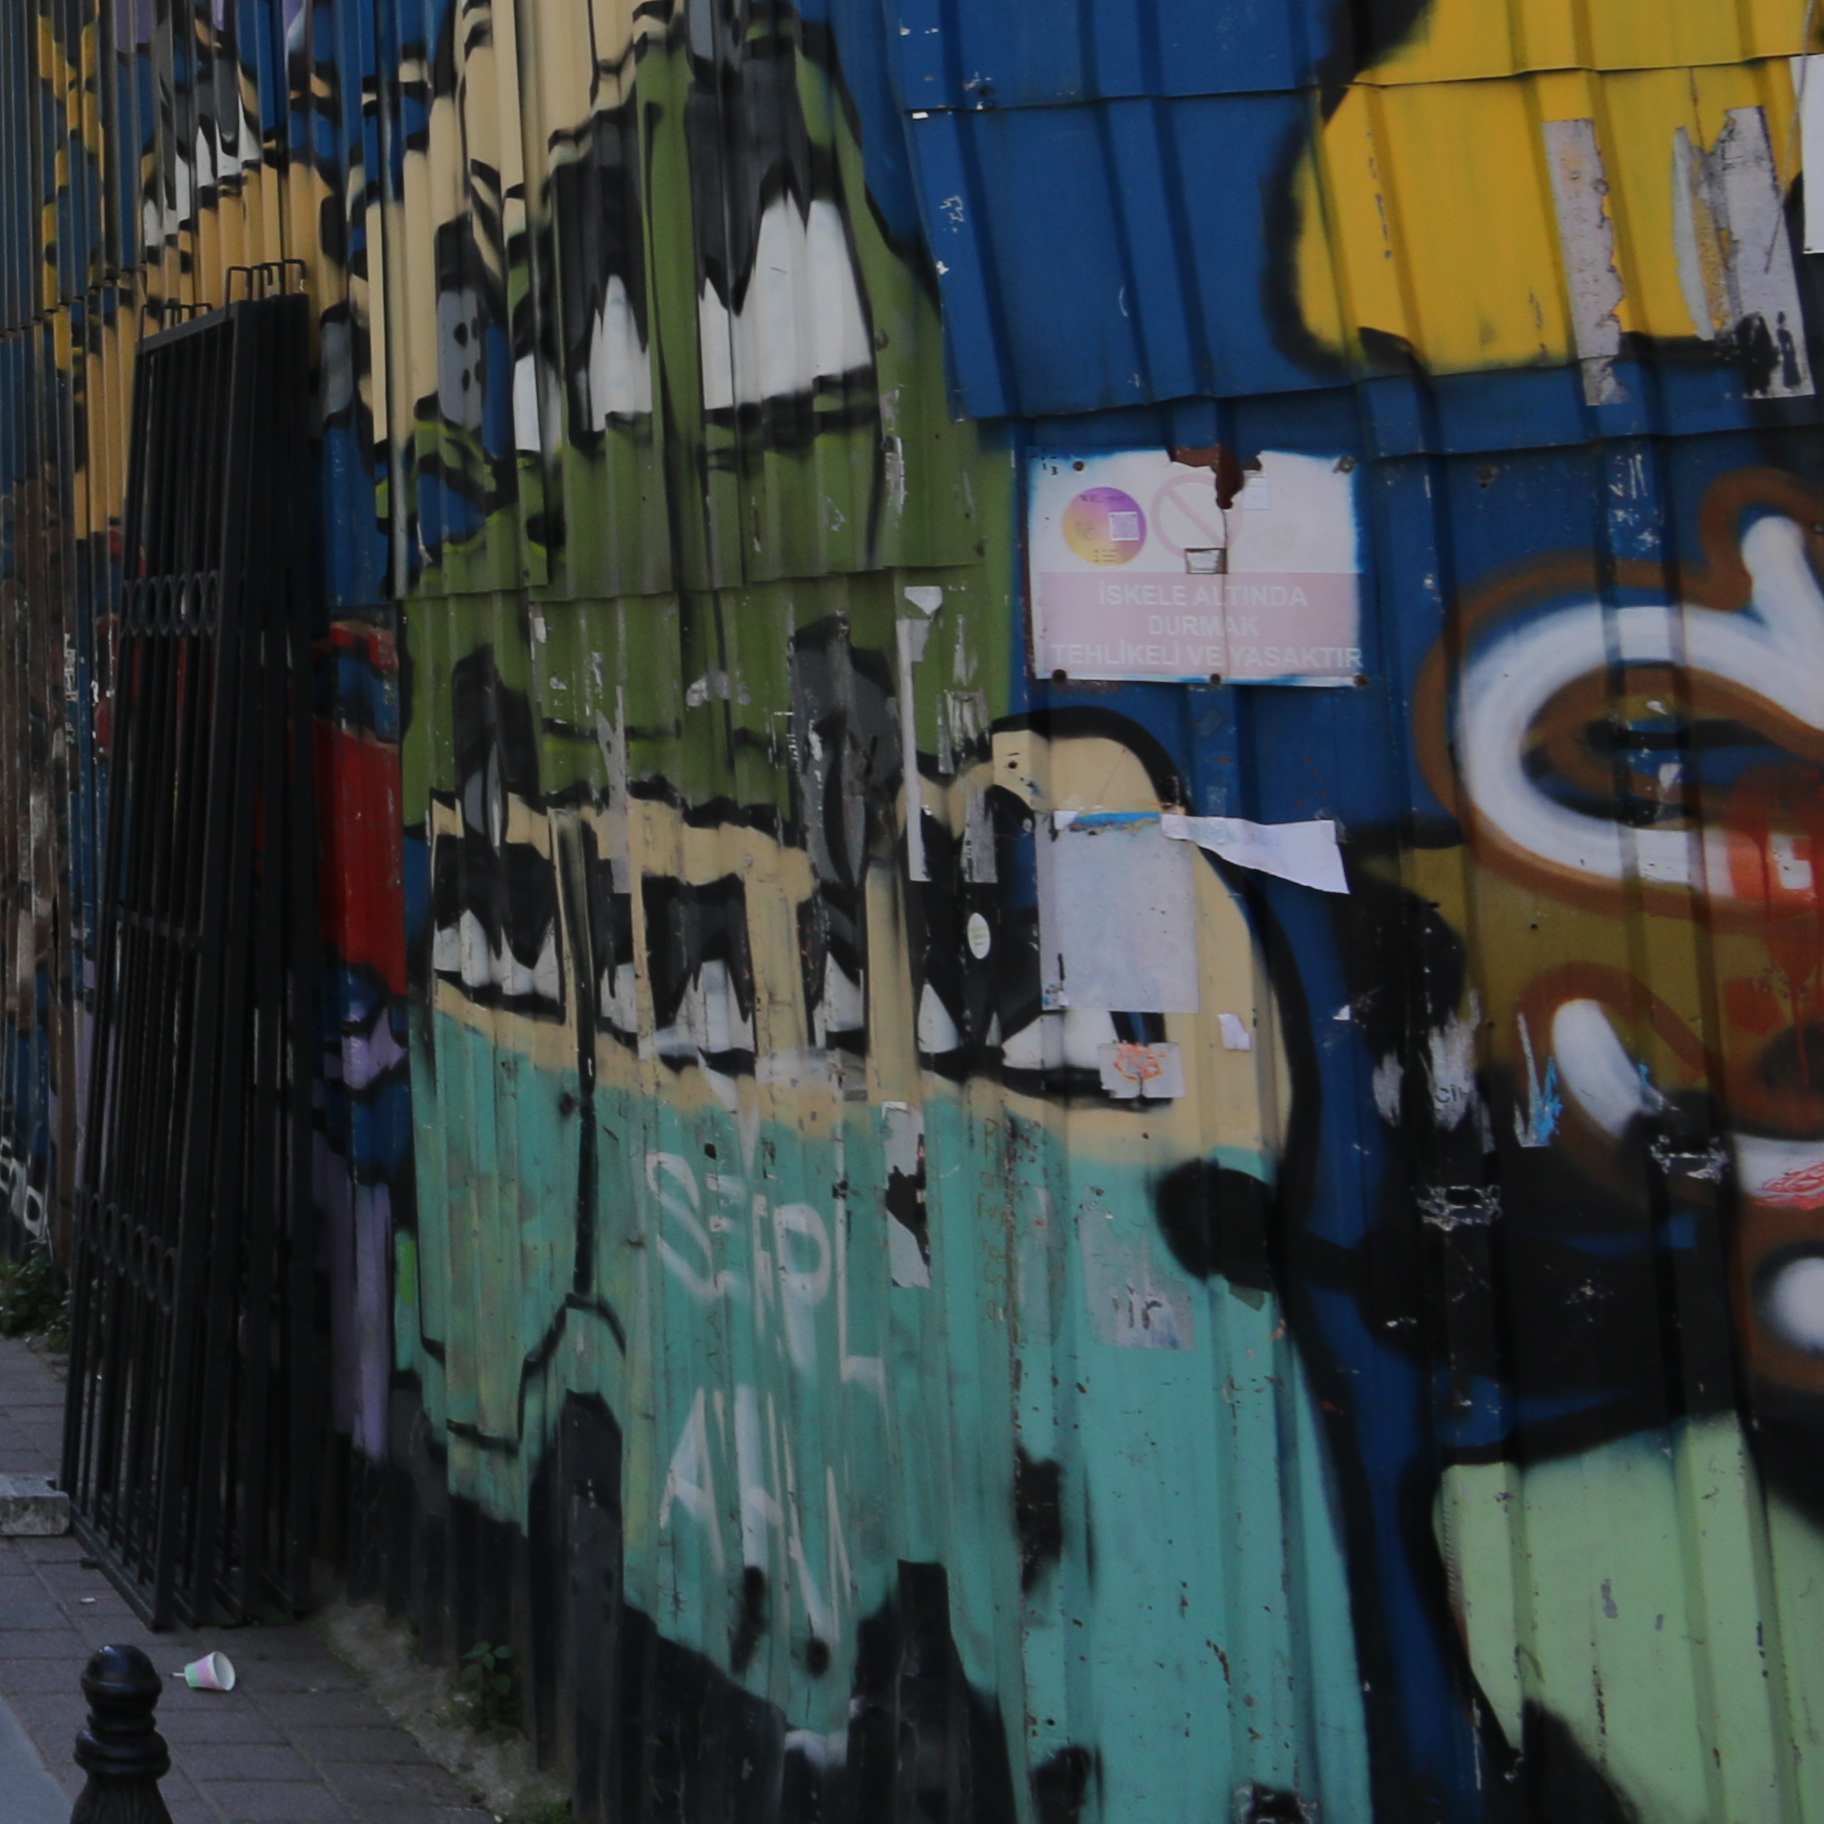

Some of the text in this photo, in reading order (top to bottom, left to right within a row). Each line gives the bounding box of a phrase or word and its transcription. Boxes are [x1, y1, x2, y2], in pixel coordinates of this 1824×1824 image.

[1099, 579, 1308, 607] İSKELE ALTINDA
[1149, 615, 1259, 637] DURMAK
[1054, 639, 1363, 668] TEHLİKELİ VE YASAKTIR
